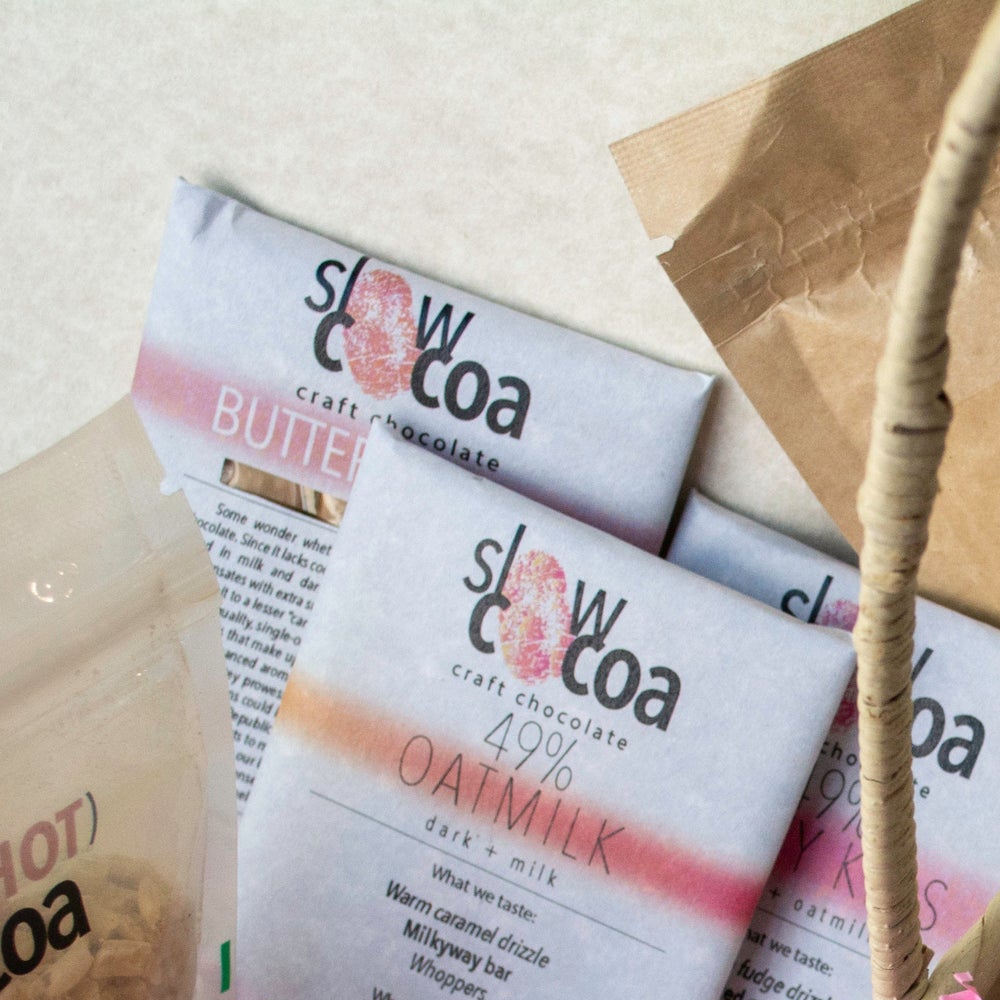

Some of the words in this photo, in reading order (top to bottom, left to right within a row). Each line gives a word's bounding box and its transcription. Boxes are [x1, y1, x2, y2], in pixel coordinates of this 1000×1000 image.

[296, 384, 357, 420] craft
[216, 502, 248, 525] Some
[254, 519, 298, 544] wonder
[219, 545, 231, 560] in
[237, 554, 264, 571] milk
[270, 567, 294, 582] and
[240, 532, 271, 555] Since
[271, 545, 281, 558] it
[281, 549, 309, 568] lacks
[230, 589, 242, 602] to
[242, 595, 251, 607] a
[252, 598, 286, 619] lesser
[249, 577, 274, 596] with
[275, 589, 304, 608] extra
[226, 627, 250, 647] that
[251, 639, 282, 659] make
[241, 695, 273, 715] could
[452, 663, 506, 696] craft
[515, 692, 628, 751] chocolate
[484, 713, 578, 791] 49%
[399, 735, 625, 875] OATMILK
[425, 815, 473, 848] dark
[510, 854, 559, 887] milk
[432, 863, 470, 893] What
[473, 885, 495, 904] we
[496, 895, 537, 924] taste:
[385, 879, 433, 916] Warm
[433, 906, 500, 944] caramel
[497, 933, 551, 969] drizzle
[402, 918, 484, 974] Milkyway
[484, 955, 513, 983] bar
[769, 938, 793, 958] we
[792, 948, 833, 978] taste:
[737, 959, 786, 997] fudge
